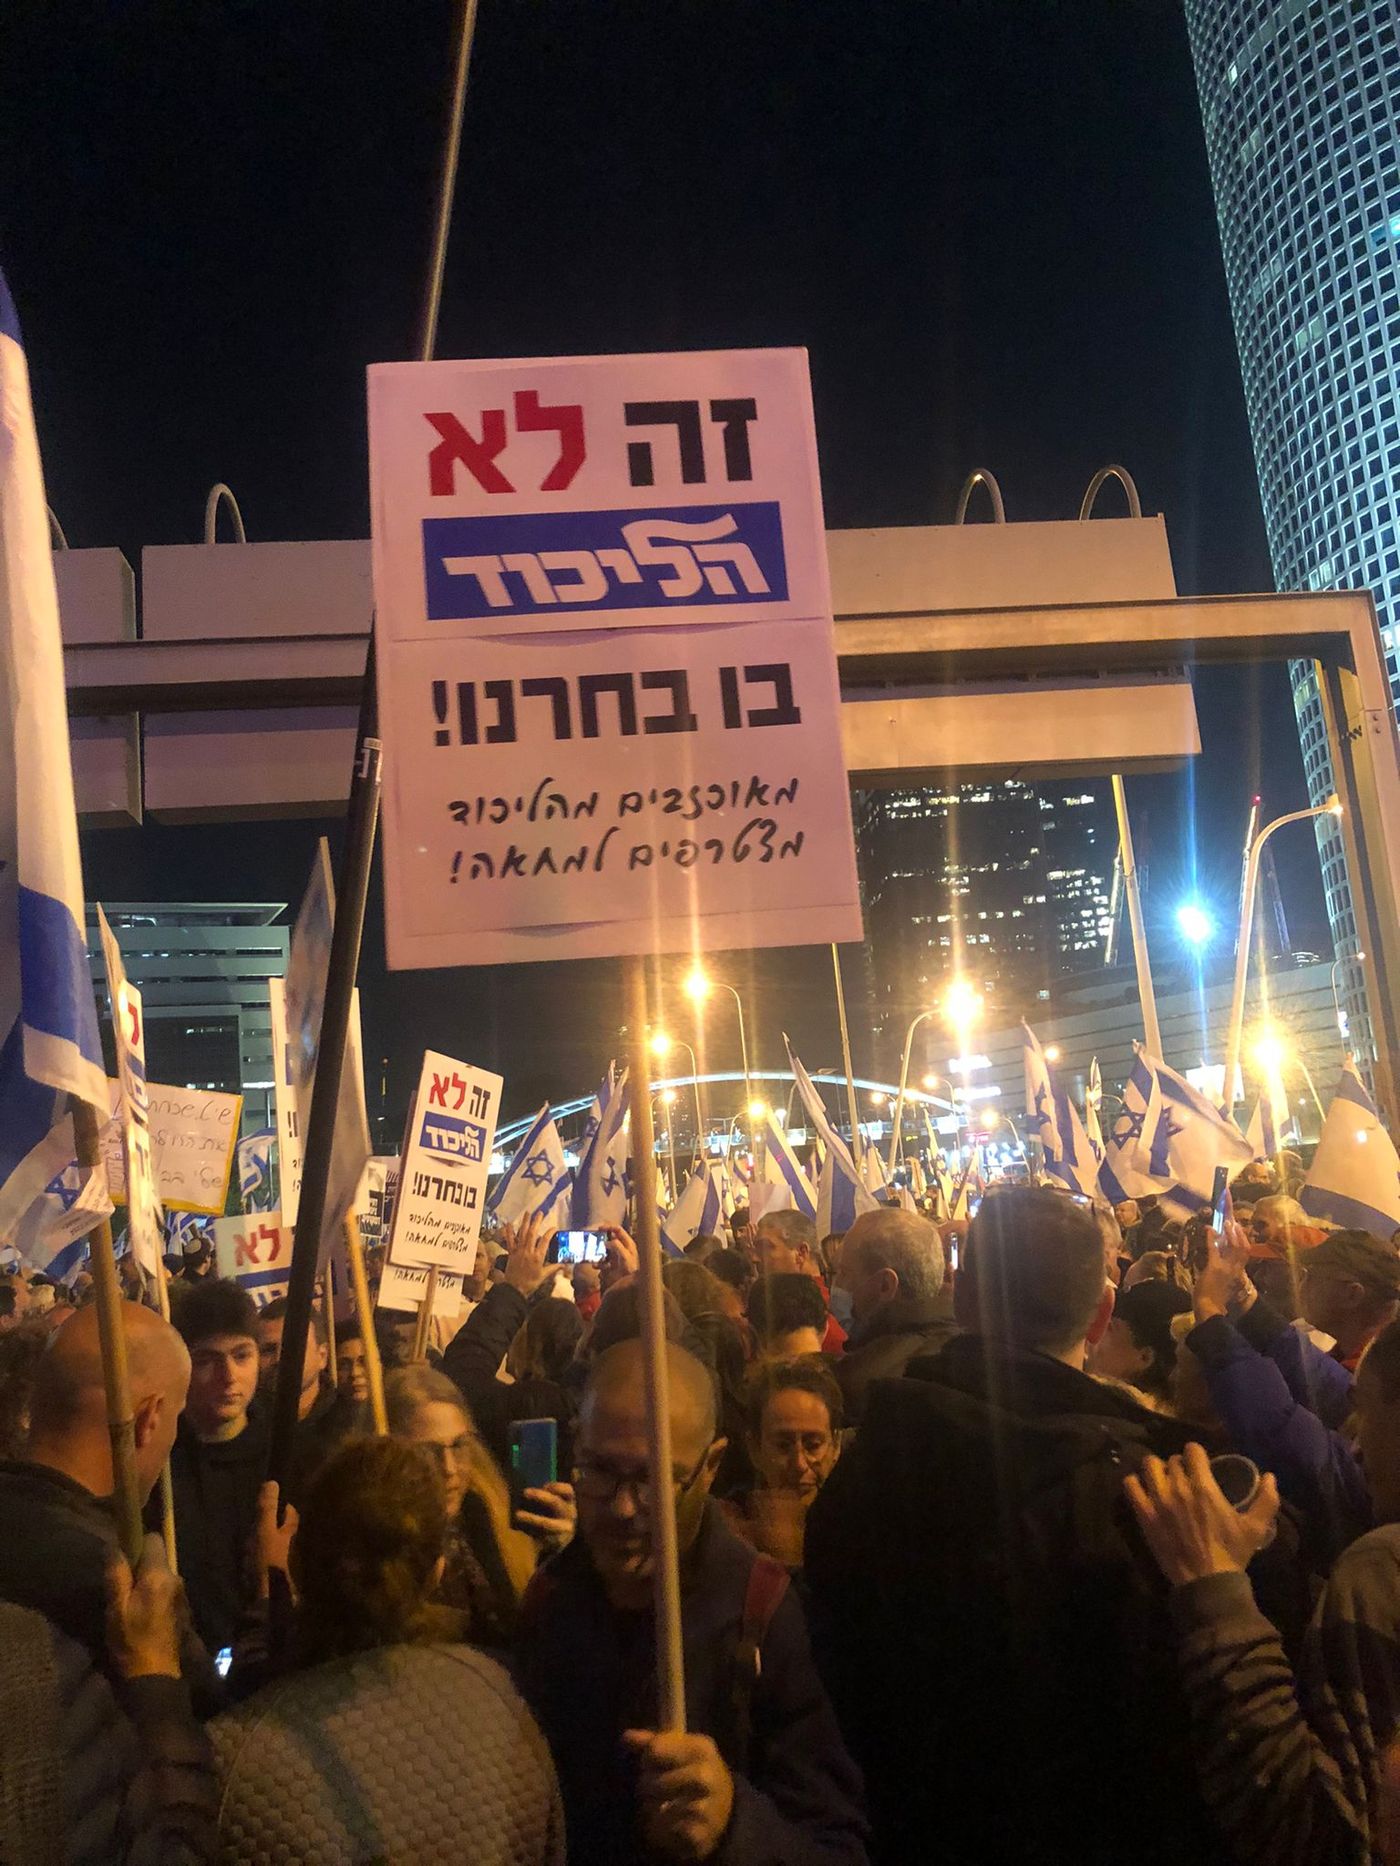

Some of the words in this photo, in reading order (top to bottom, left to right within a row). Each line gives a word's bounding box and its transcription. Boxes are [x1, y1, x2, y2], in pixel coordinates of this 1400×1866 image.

[423, 390, 588, 496] לא
[624, 397, 758, 487] זה
[442, 513, 773, 608] הליכוד
[431, 668, 698, 747] בחרנו!
[718, 662, 802, 730] בו
[447, 776, 599, 826] מהליכוד
[618, 775, 798, 820] מאוכזבים
[449, 826, 620, 884] למחאה!
[628, 818, 804, 871] מצטרפים
[429, 1072, 467, 1111] לא
[469, 1085, 491, 1120] זה
[233, 1224, 281, 1267] לא
